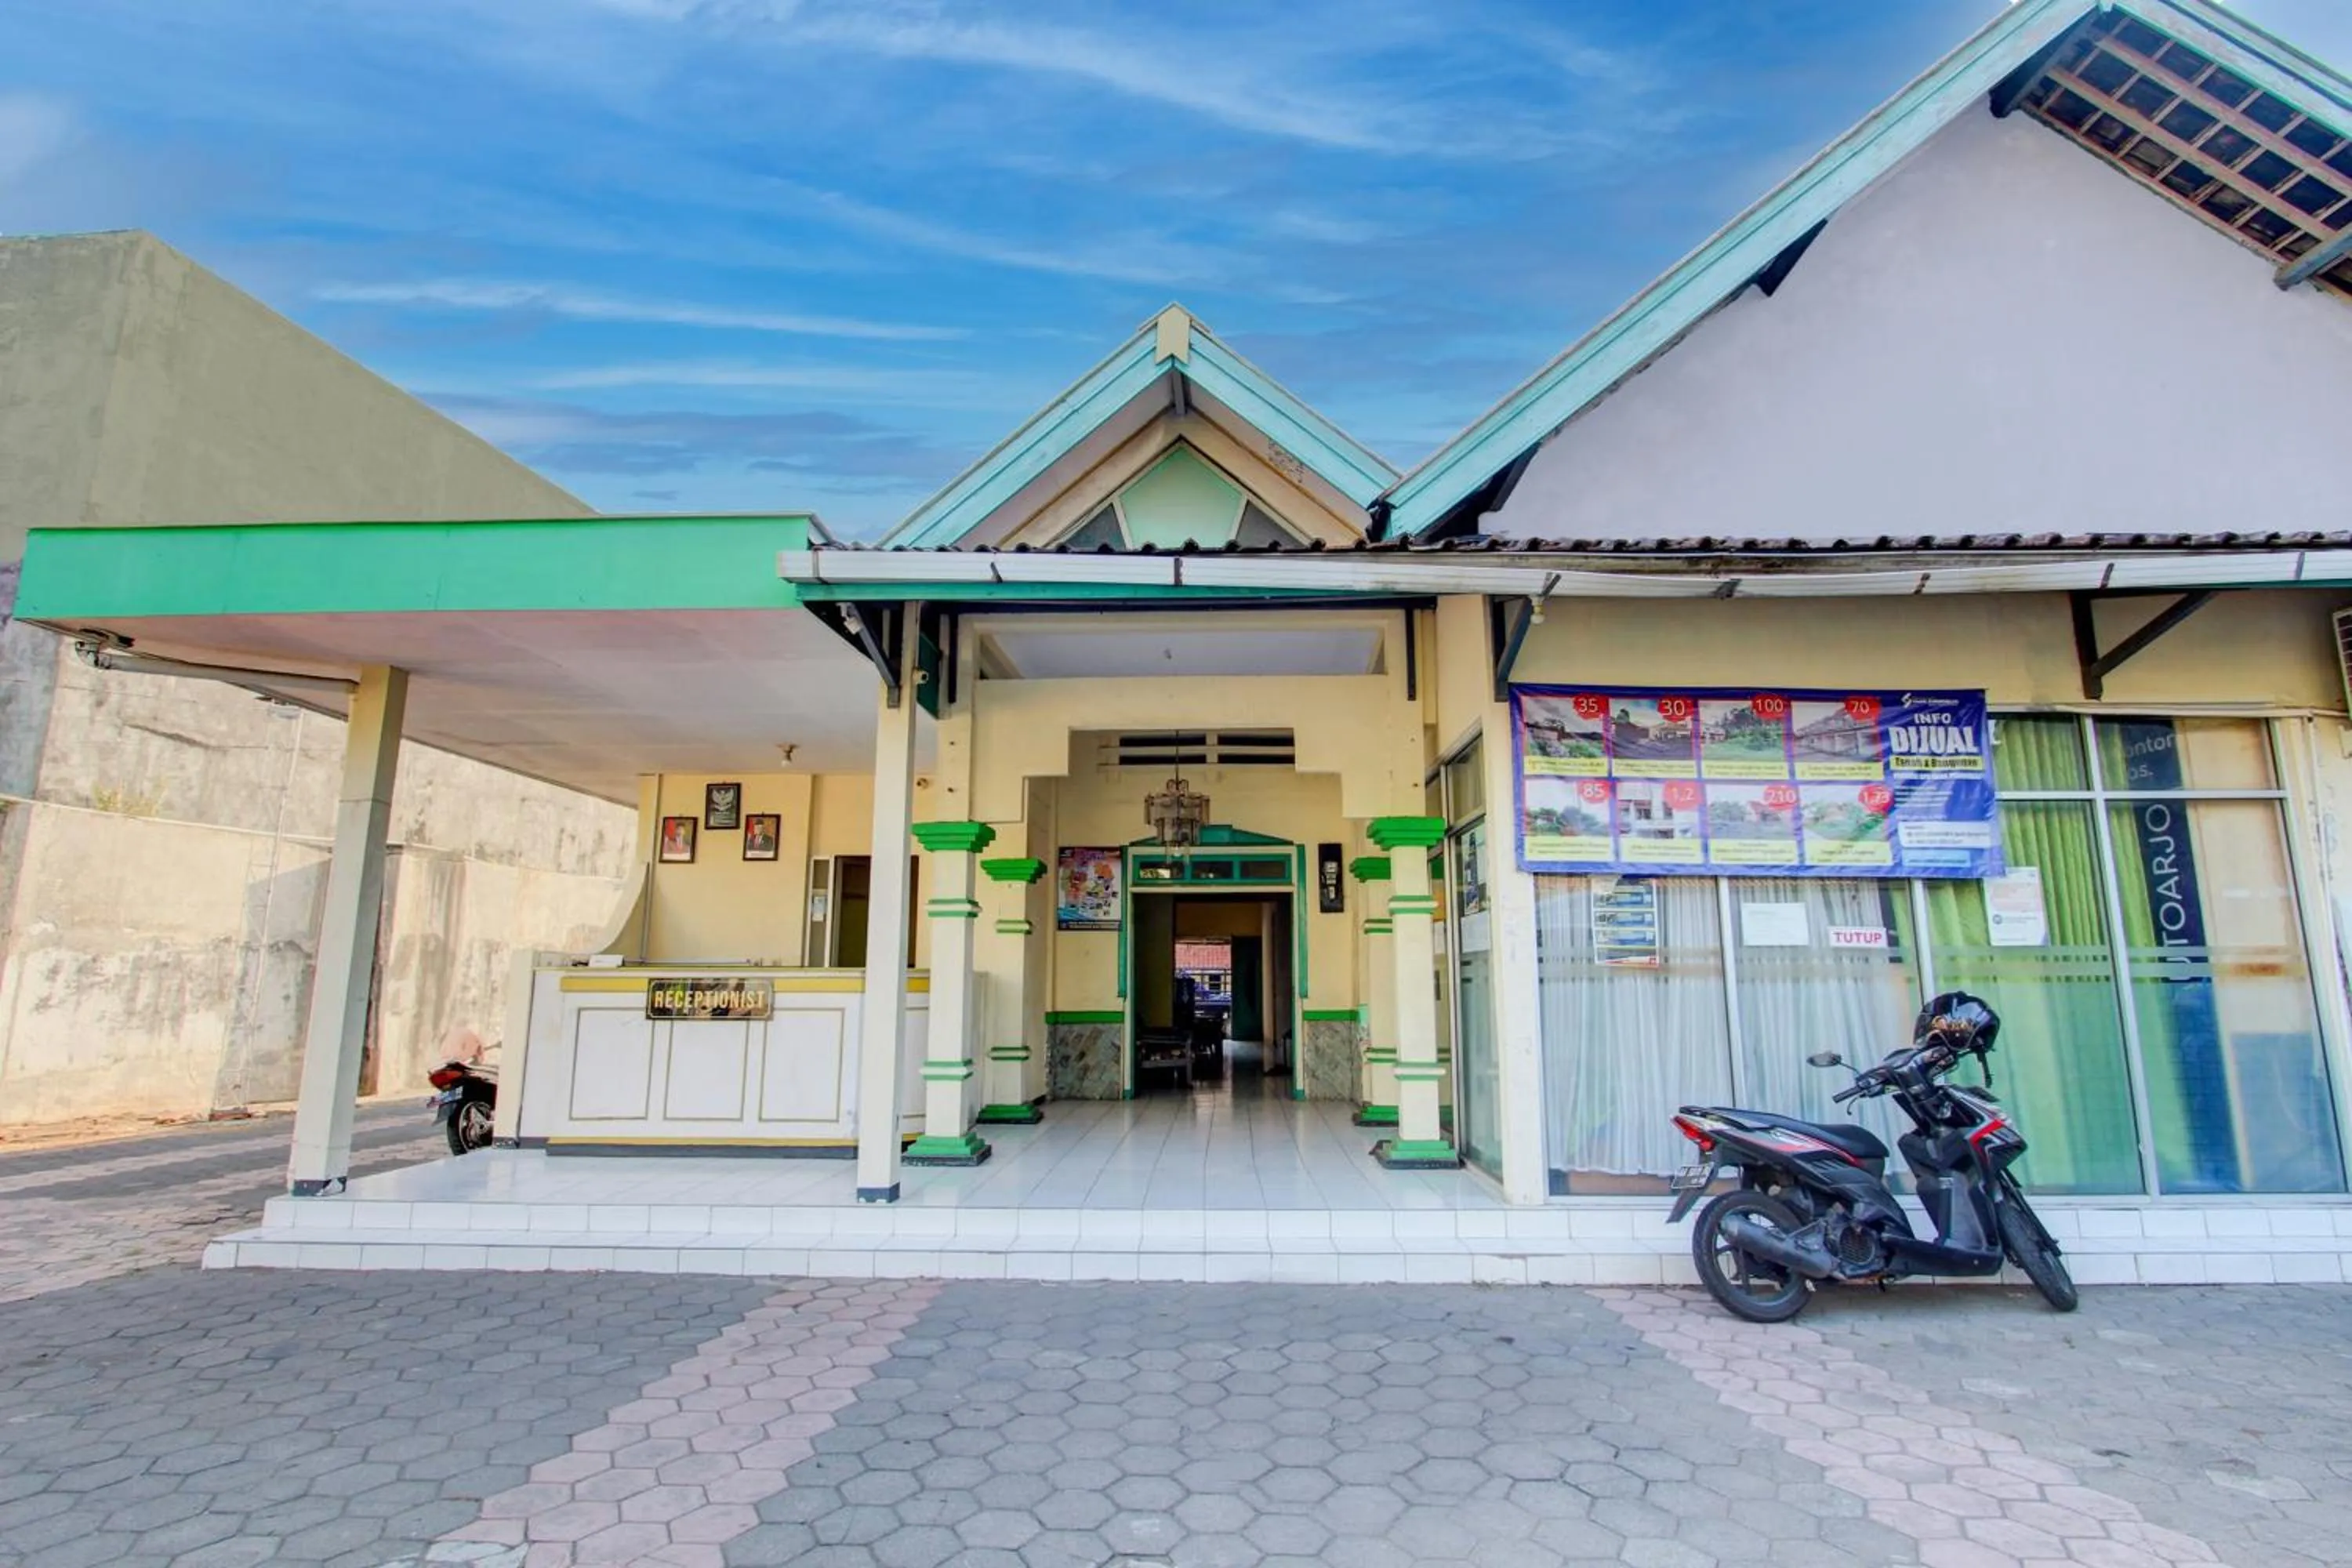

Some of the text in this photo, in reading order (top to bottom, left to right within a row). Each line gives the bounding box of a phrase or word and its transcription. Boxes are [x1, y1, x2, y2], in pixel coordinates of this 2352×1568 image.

[1577, 698, 1599, 713] 35
[1661, 699, 1686, 717] 30
[1755, 699, 1784, 713] 100
[1850, 700, 1870, 714] 70
[1914, 713, 1951, 724] INFO
[1888, 725, 1979, 754] DIJUAL
[1583, 784, 1605, 798] 85
[1767, 789, 1797, 804] 210
[1832, 931, 1882, 944] TUTUP
[654, 990, 765, 1009] RECEPTIONIST
